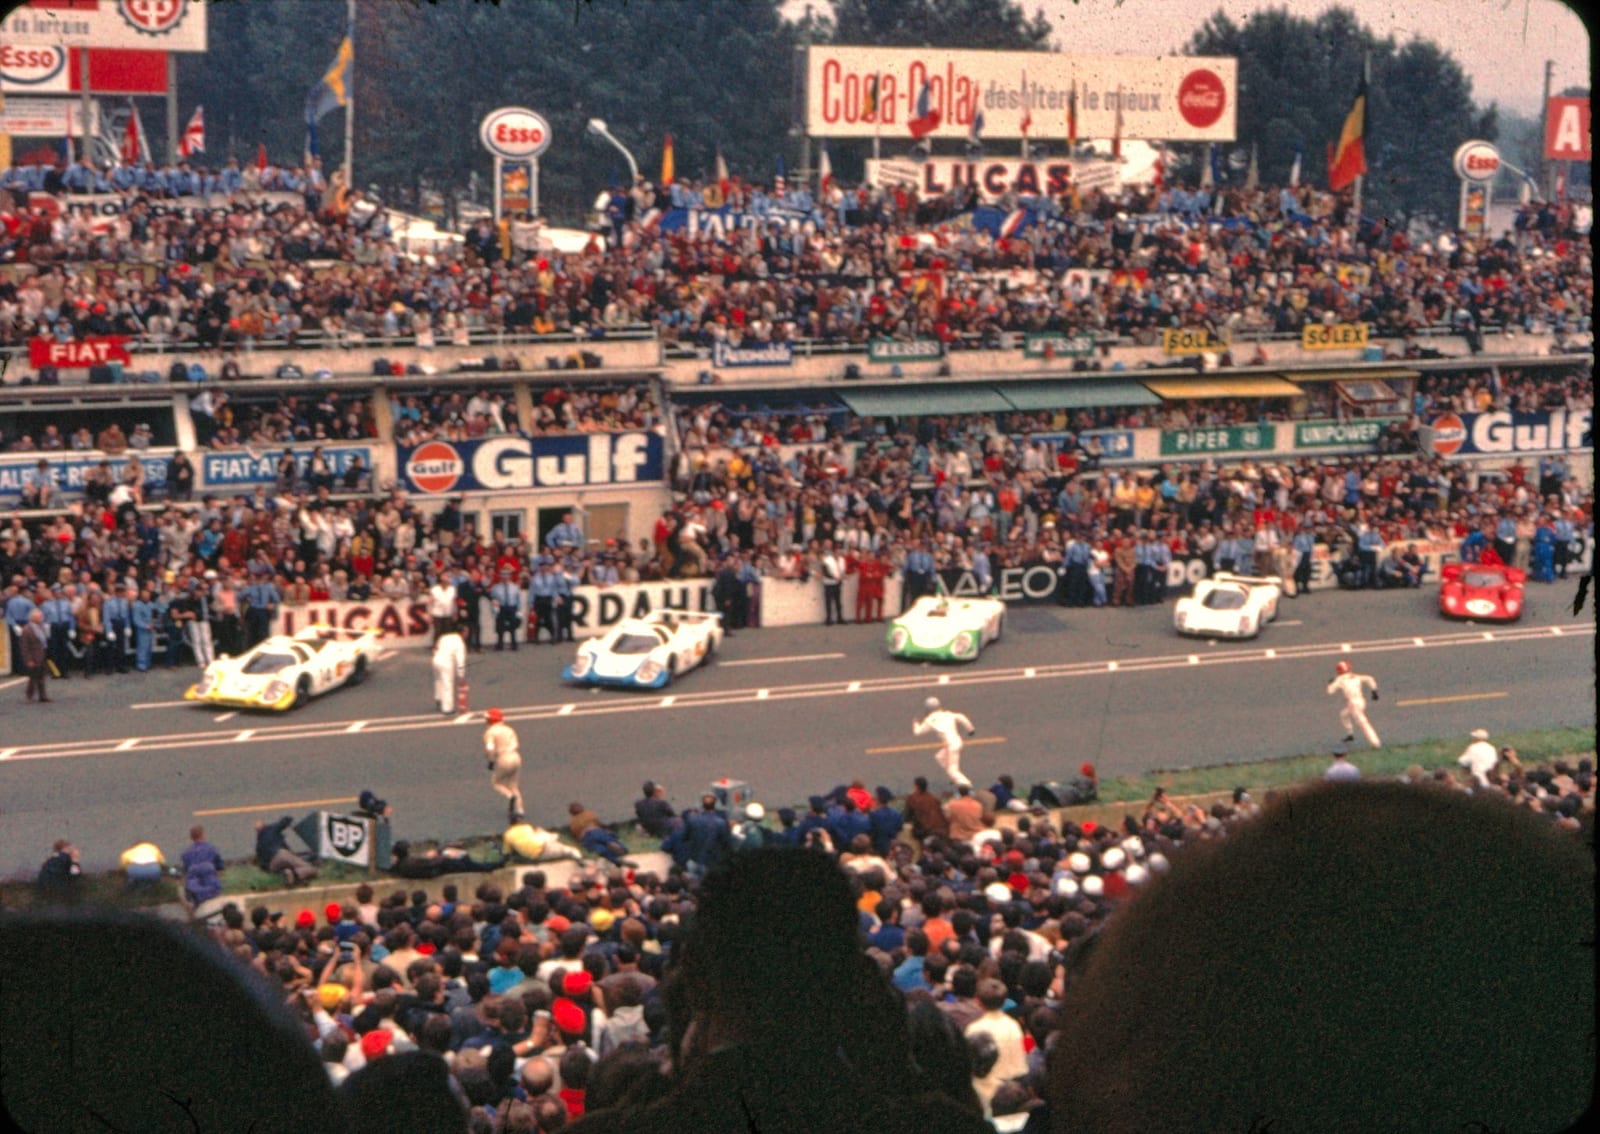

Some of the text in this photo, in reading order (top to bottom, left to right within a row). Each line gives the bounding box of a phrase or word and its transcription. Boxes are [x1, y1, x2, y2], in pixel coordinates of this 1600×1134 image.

[1082, 81, 1099, 111] le
[496, 123, 541, 143] Esso
[1553, 104, 1582, 152] A
[1466, 154, 1499, 171] Esso
[924, 163, 1073, 194] LUCAS
[1169, 332, 1228, 350] SOL
[1308, 327, 1362, 345] SOLEX
[50, 343, 110, 362] FIAT
[1176, 431, 1229, 449] PIPER
[1302, 424, 1381, 443] UNIPOWER
[1472, 409, 1592, 453] Gulf
[413, 433, 648, 489] Gulf Gulf
[332, 821, 363, 850] BP
